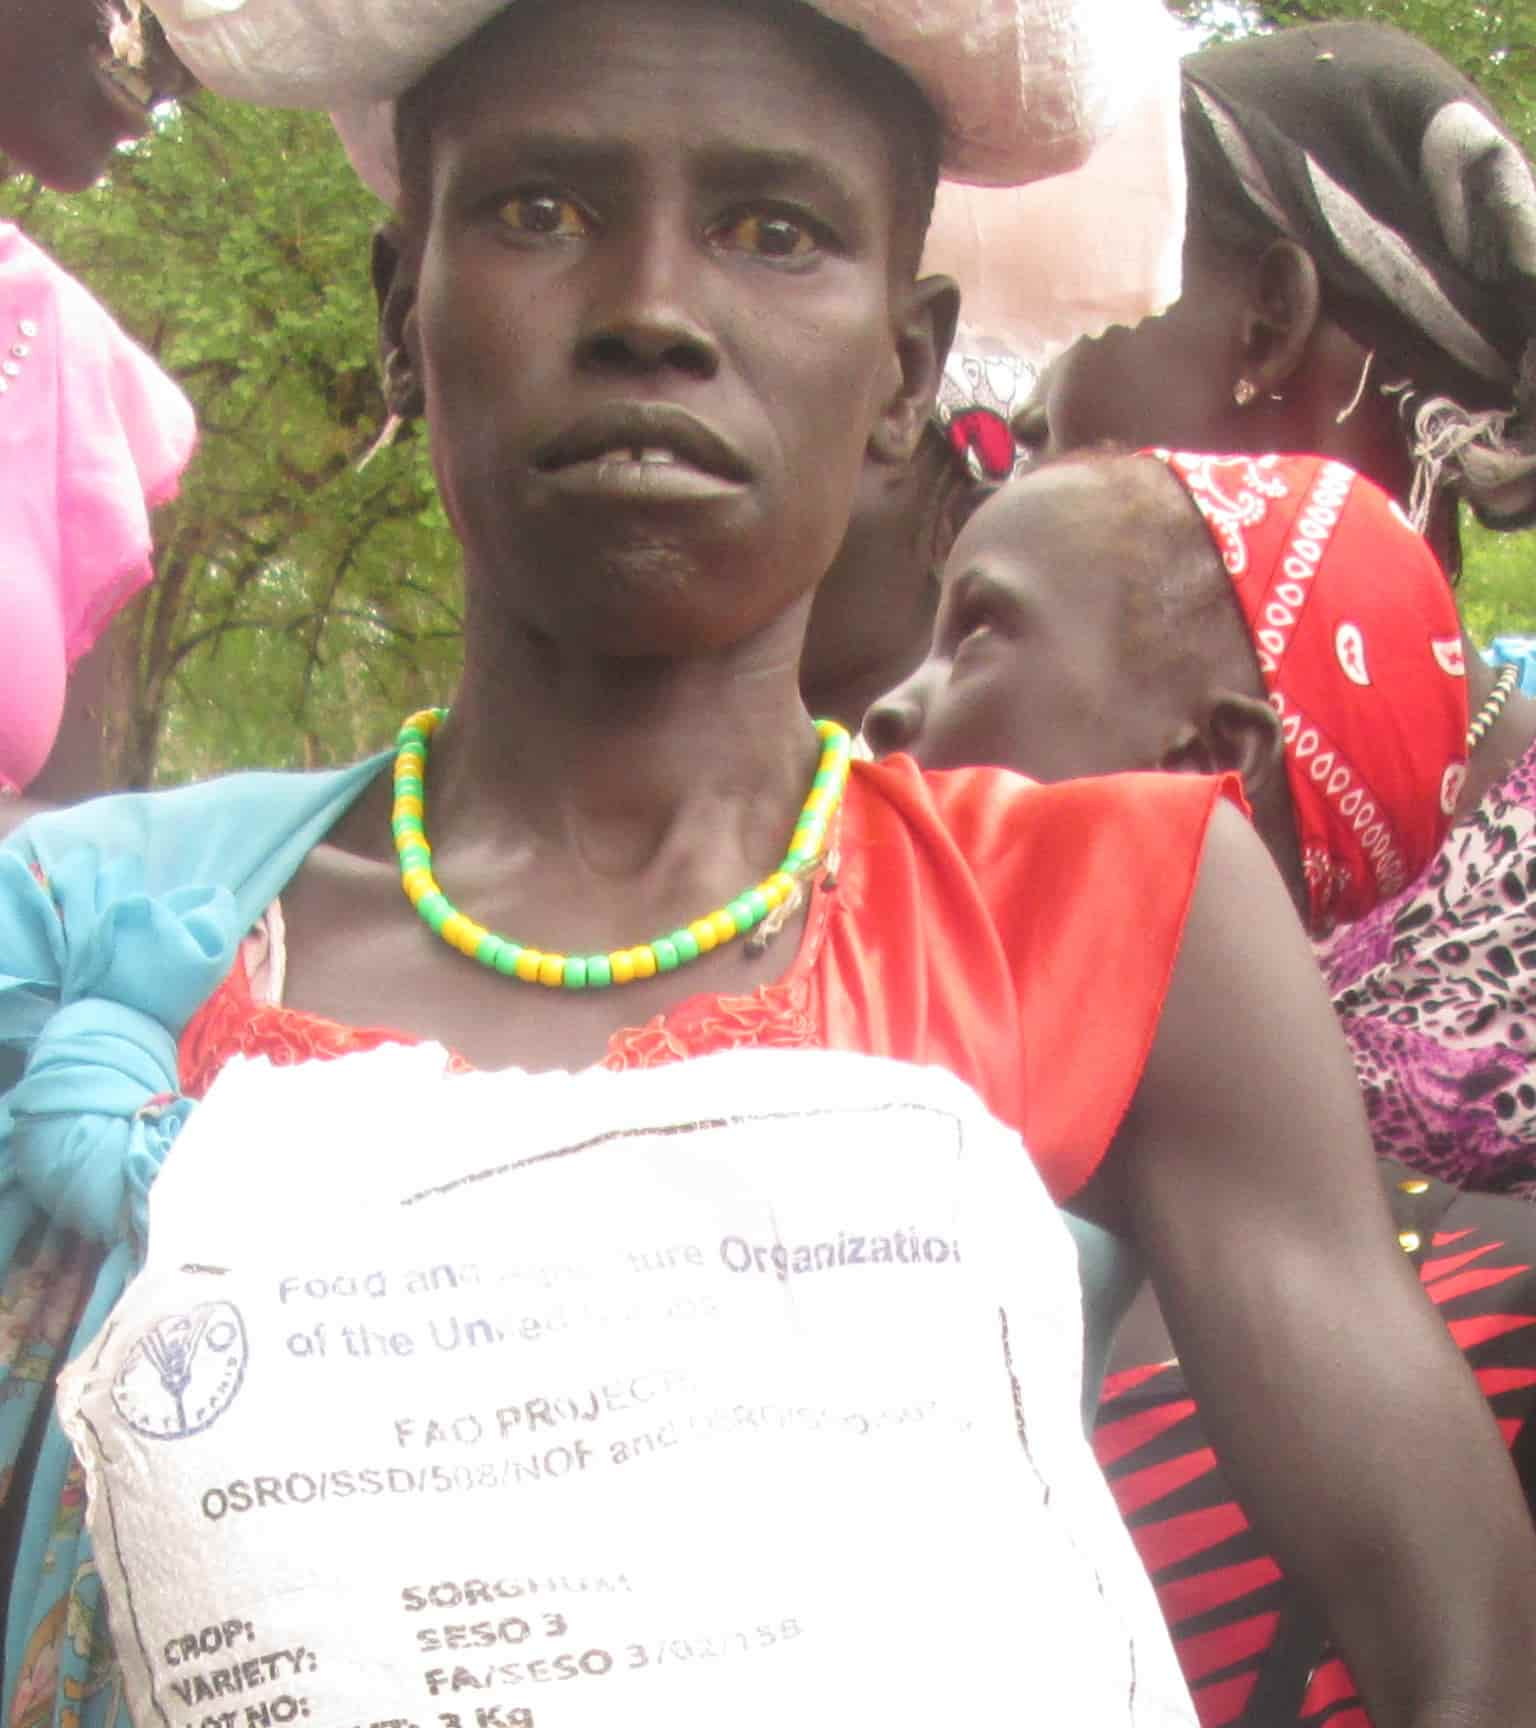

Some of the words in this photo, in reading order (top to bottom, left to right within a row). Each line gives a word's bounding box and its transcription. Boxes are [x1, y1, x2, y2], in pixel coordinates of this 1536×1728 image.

[277, 1269, 387, 1304] Food
[285, 1320, 327, 1358] of
[341, 1319, 416, 1358] the
[392, 1412, 483, 1449] FAO
[608, 1420, 679, 1465] and
[163, 1618, 257, 1667] CROP:
[170, 1645, 320, 1708] VARIETY:
[416, 1615, 532, 1653] SESO
[542, 1611, 568, 1640] 3
